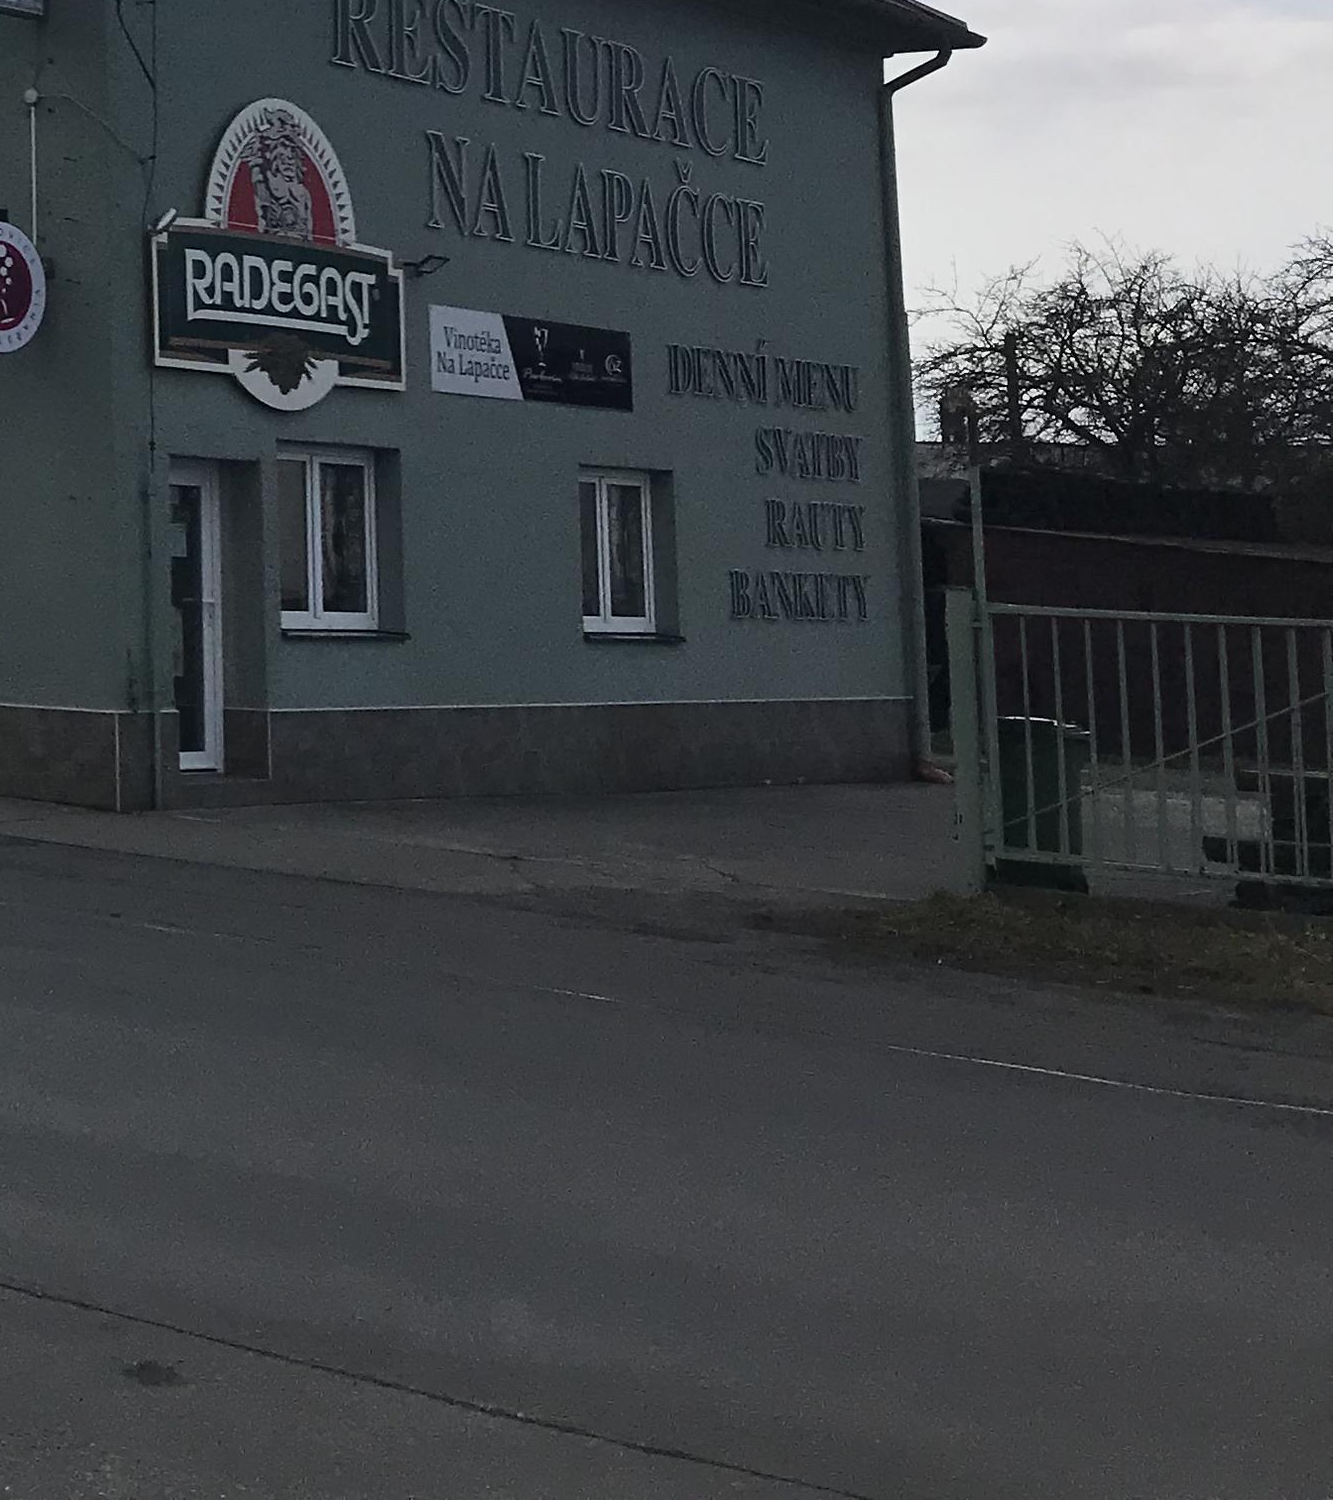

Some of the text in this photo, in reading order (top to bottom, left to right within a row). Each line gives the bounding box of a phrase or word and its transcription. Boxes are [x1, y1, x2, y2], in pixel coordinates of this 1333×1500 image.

[426, 129, 771, 289] NA LAPAČCE
[184, 248, 377, 346] RADEGAST
[437, 351, 455, 374] Na
[443, 326, 502, 354] Vinotéka
[667, 338, 861, 413] DENNÍ MENU
[755, 426, 864, 483] SVATBY
[764, 497, 865, 550] RAUTY
[729, 568, 871, 622] BANKETY
